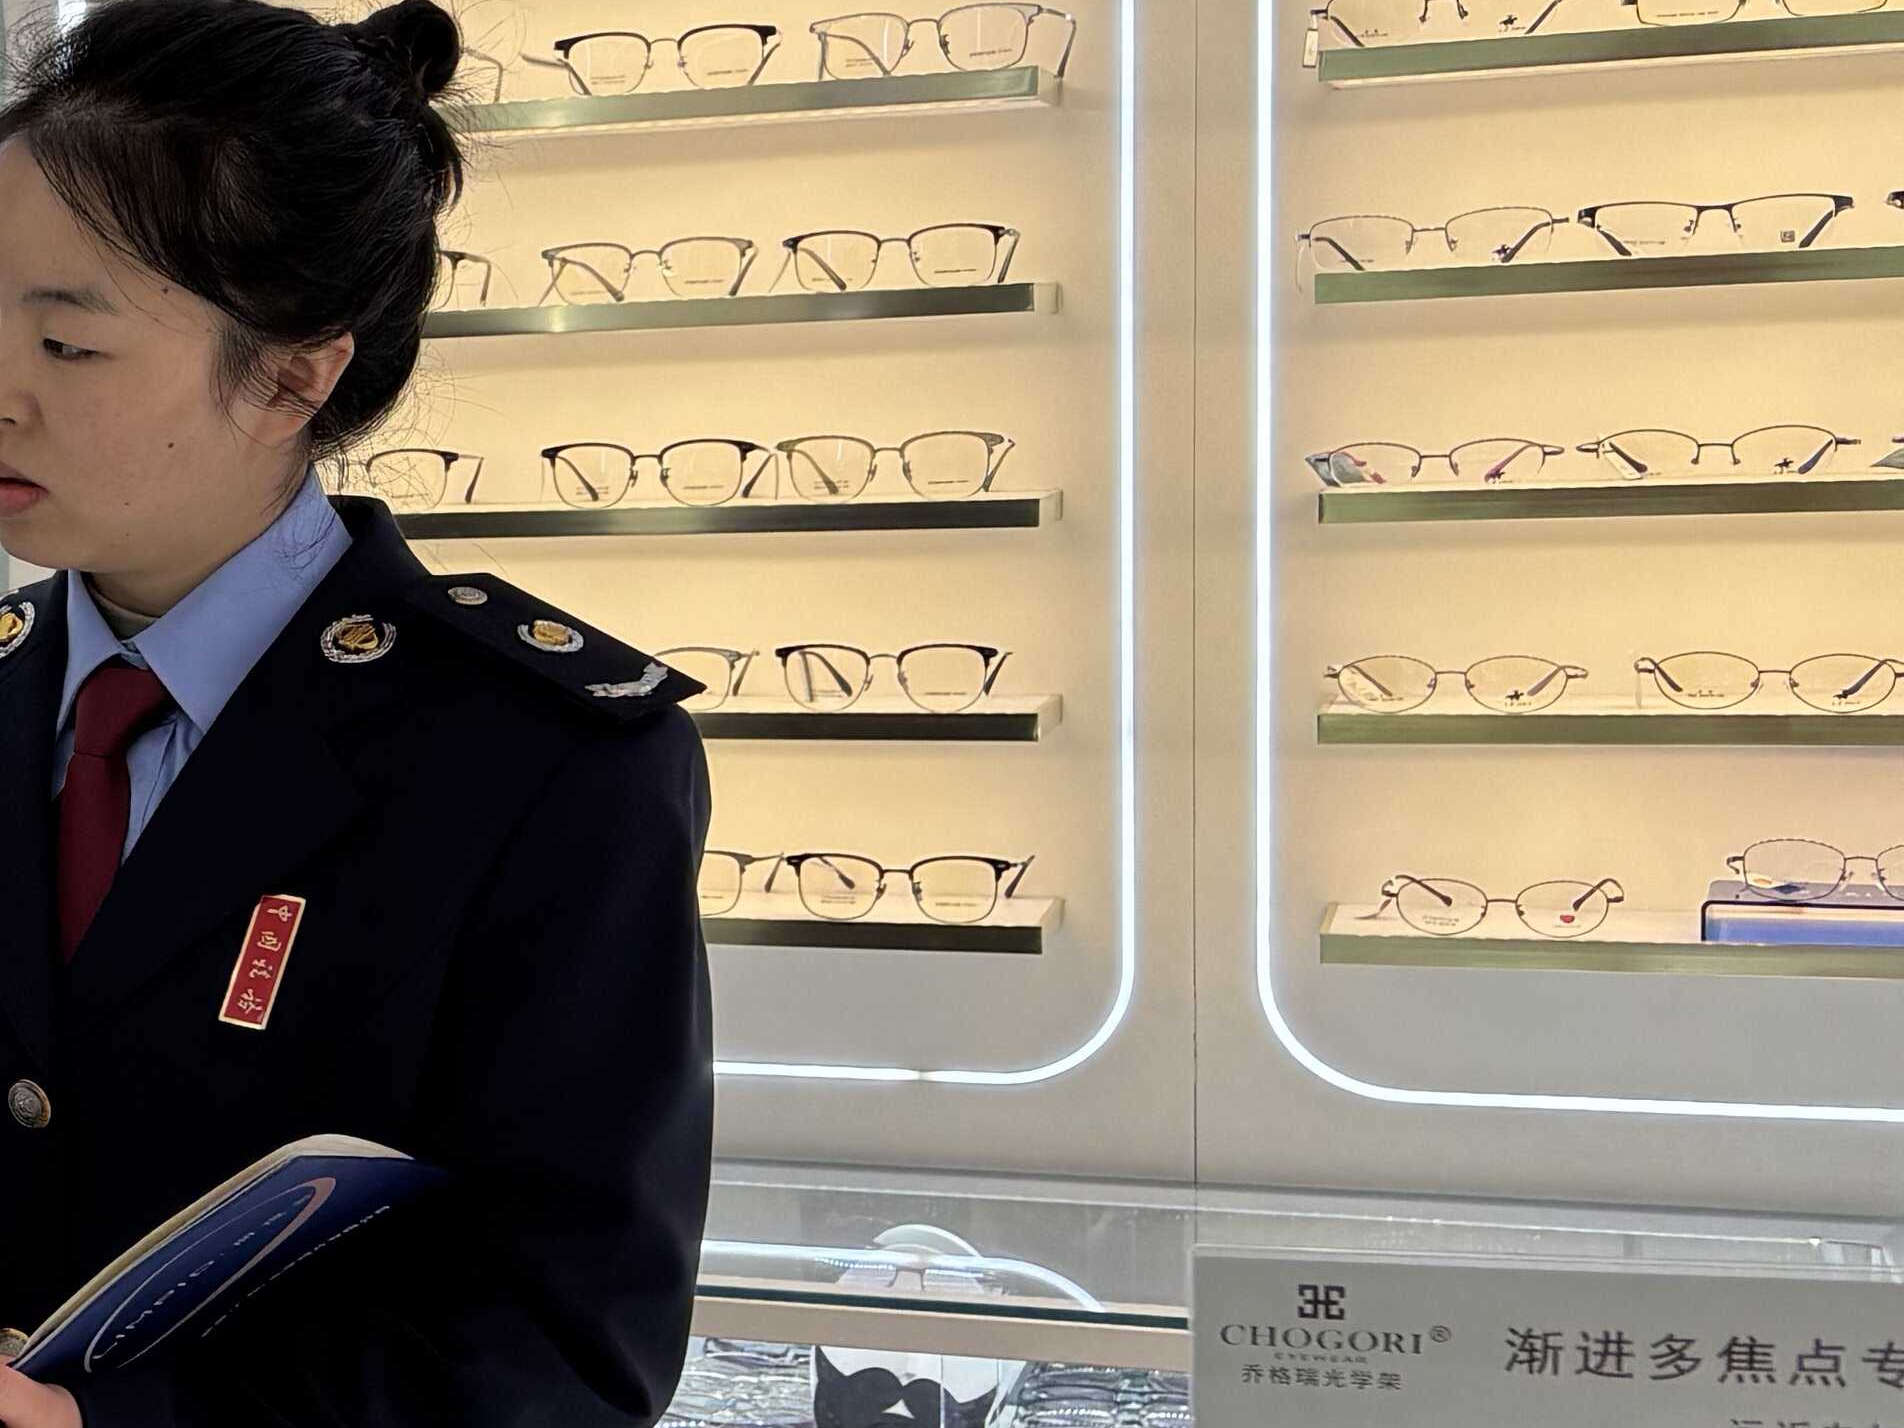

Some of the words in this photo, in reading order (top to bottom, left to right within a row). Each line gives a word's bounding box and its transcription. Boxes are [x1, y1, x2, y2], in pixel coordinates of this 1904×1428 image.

[236, 905, 292, 1014] 中国税务
[1504, 1327, 1904, 1389] 渐进多焦点专
